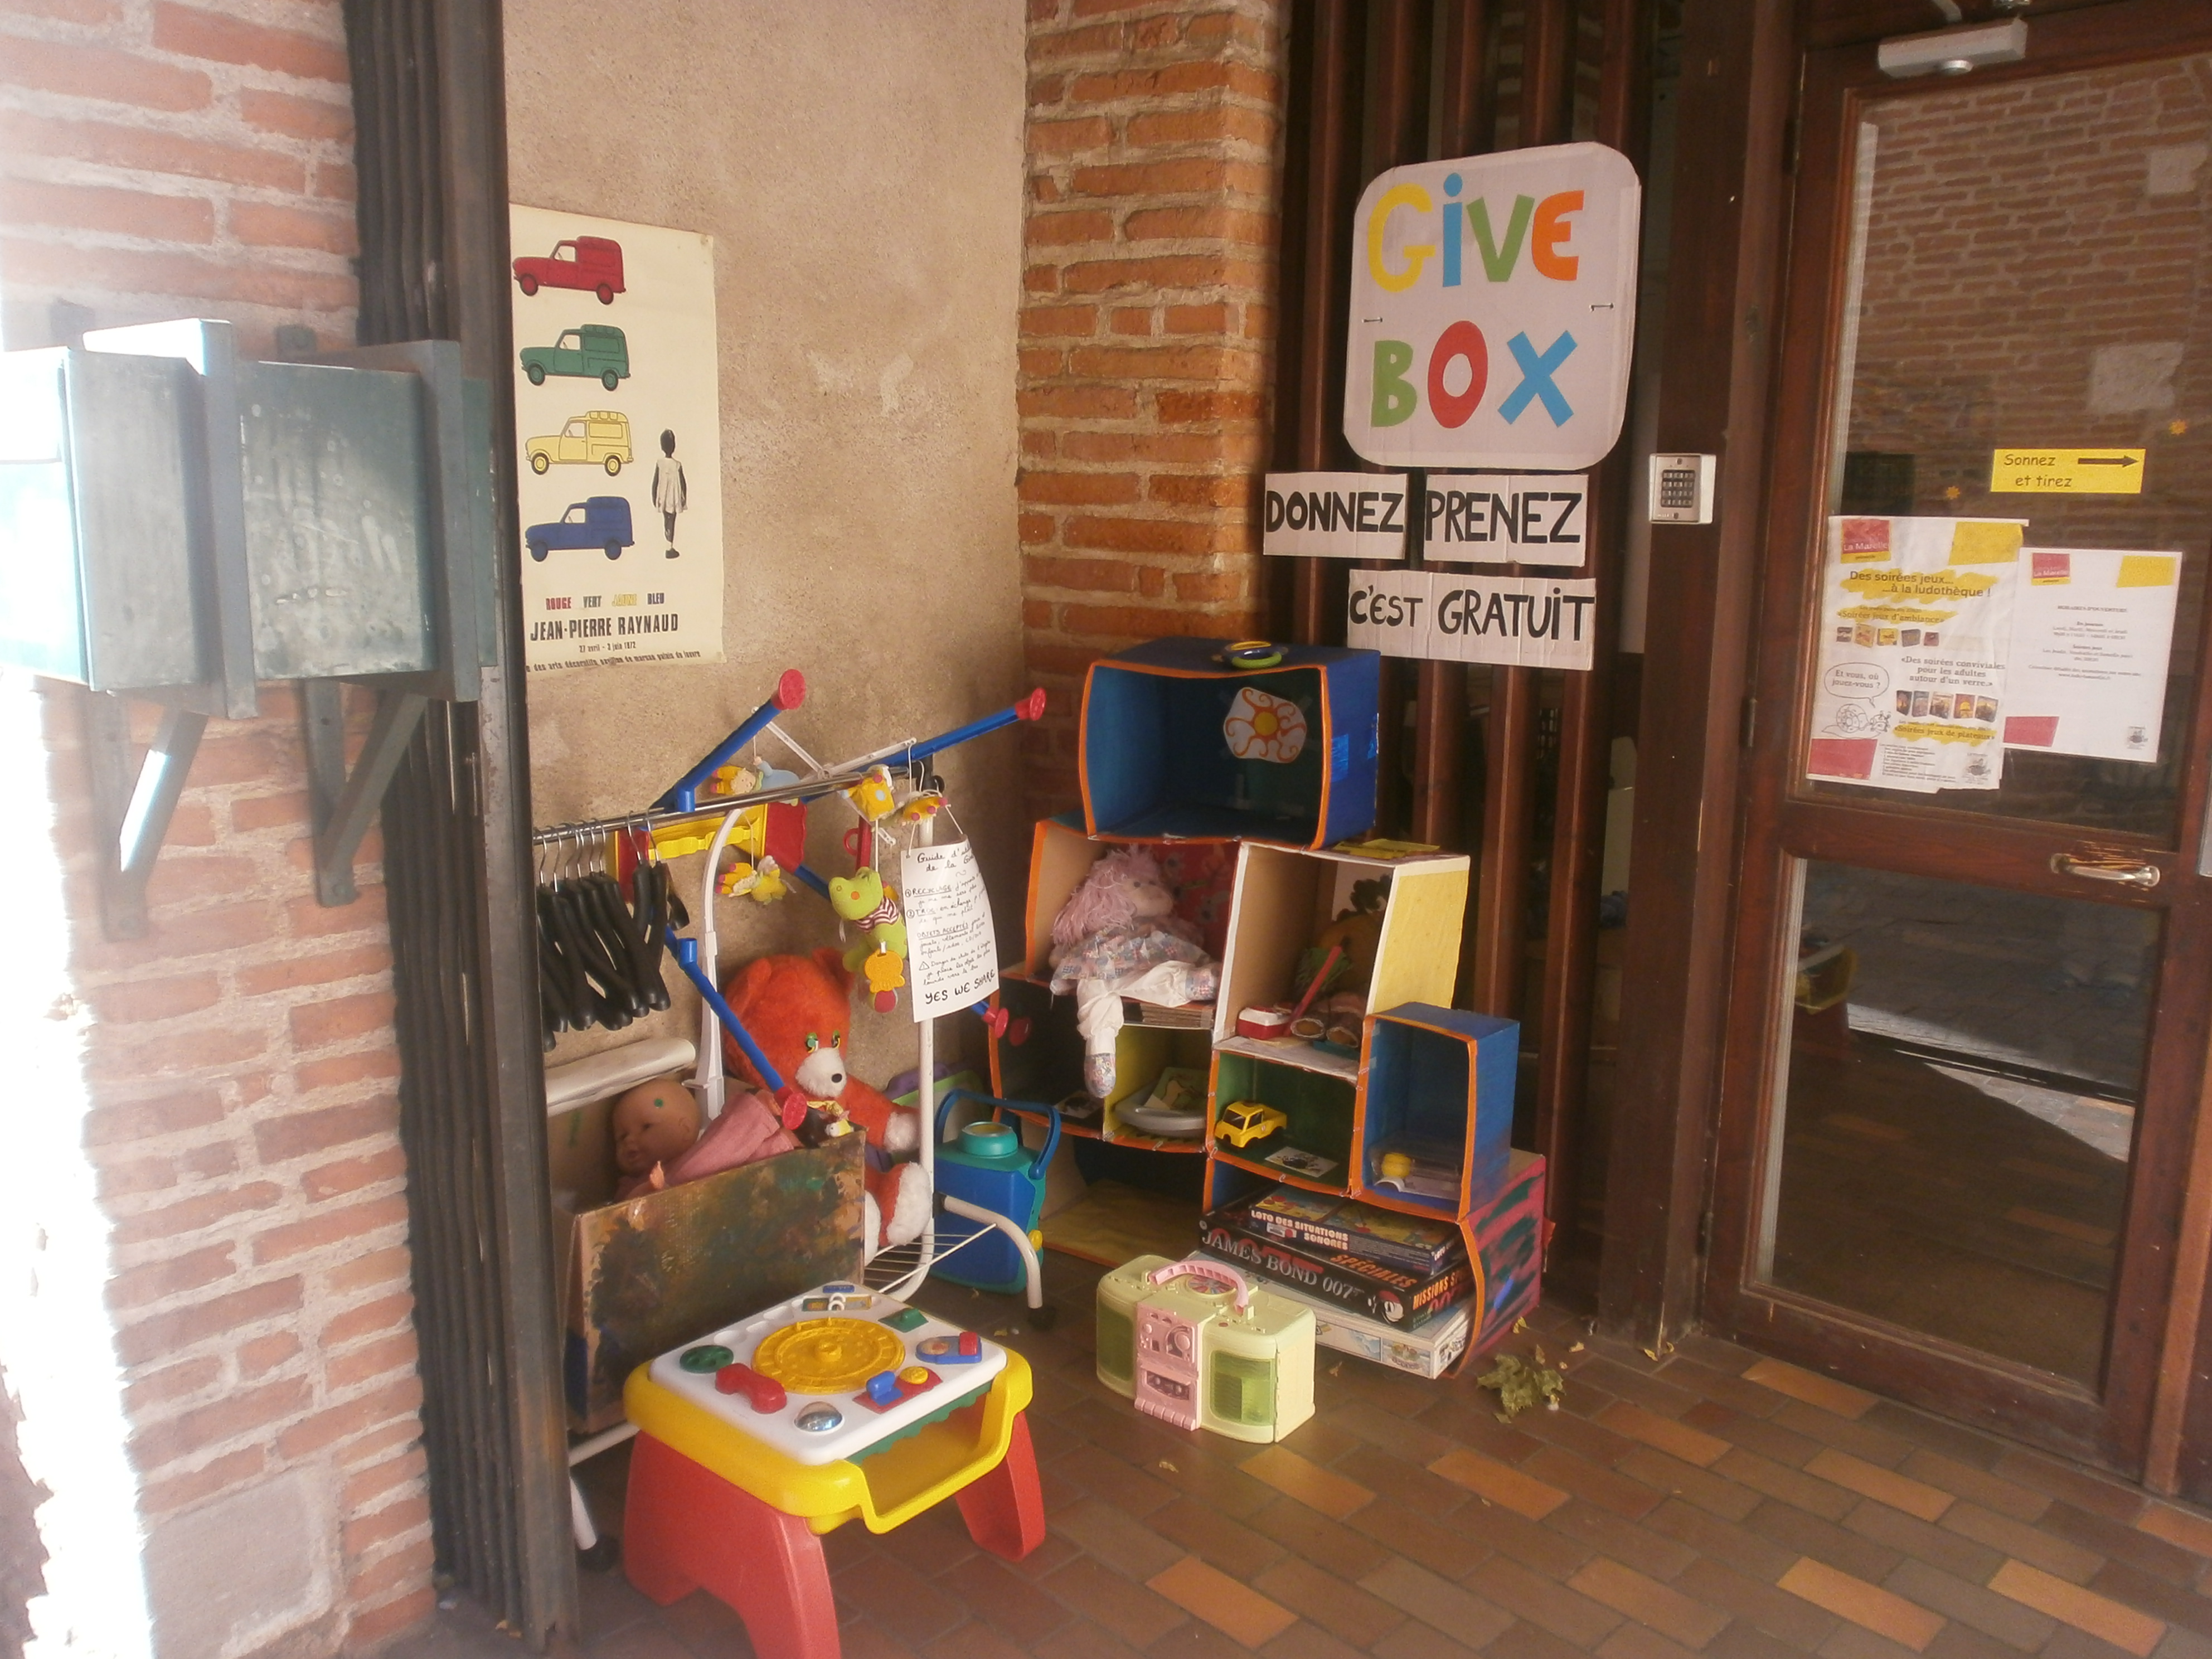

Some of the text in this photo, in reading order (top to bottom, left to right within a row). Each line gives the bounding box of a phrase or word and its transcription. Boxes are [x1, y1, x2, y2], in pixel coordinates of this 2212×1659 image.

[1371, 320, 1577, 429] BOX
[2004, 453, 2056, 467] Sonnez
[2015, 475, 2073, 488] et tirez
[1265, 491, 1404, 532] DONNEZ
[1425, 489, 1585, 544] PRENEZ
[1850, 571, 1871, 581] Des
[1875, 572, 1917, 582] soirées
[1901, 585, 1912, 594] la
[1915, 585, 1983, 598] ludothèque
[546, 593, 664, 610] ROUGE VERT JAUNE BLEU
[1350, 585, 1423, 628] C'EST
[1873, 613, 1889, 622] jeux
[530, 613, 678, 641] JEAN-PIERRE RAYNAUD
[588, 643, 600, 652] avril
[612, 642, 623, 652] juin
[534, 663, 546, 672] des
[549, 661, 563, 670] arts
[1924, 658, 1954, 667] soirées
[1956, 660, 2005, 670] conviviales
[1917, 667, 1937, 676] pour
[1954, 669, 1986, 678] adultes
[1909, 675, 1937, 683] autour
[1940, 676, 1960, 685] d'un
[1927, 727, 1944, 736] jeux
[917, 852, 945, 864] Guide
[926, 864, 938, 872] de
[944, 860, 957, 869] la
[925, 969, 996, 1005] YES WE SHARE
[1251, 1210, 1274, 1223] LOTO
[1275, 1216, 1293, 1228] DES
[1294, 1220, 1348, 1242] SITUATIONS
[1304, 1233, 1348, 1250] SONORES
[1202, 1230, 1356, 1299] JAMES BOND 007
[1413, 1276, 1449, 1310] MISSIONS
